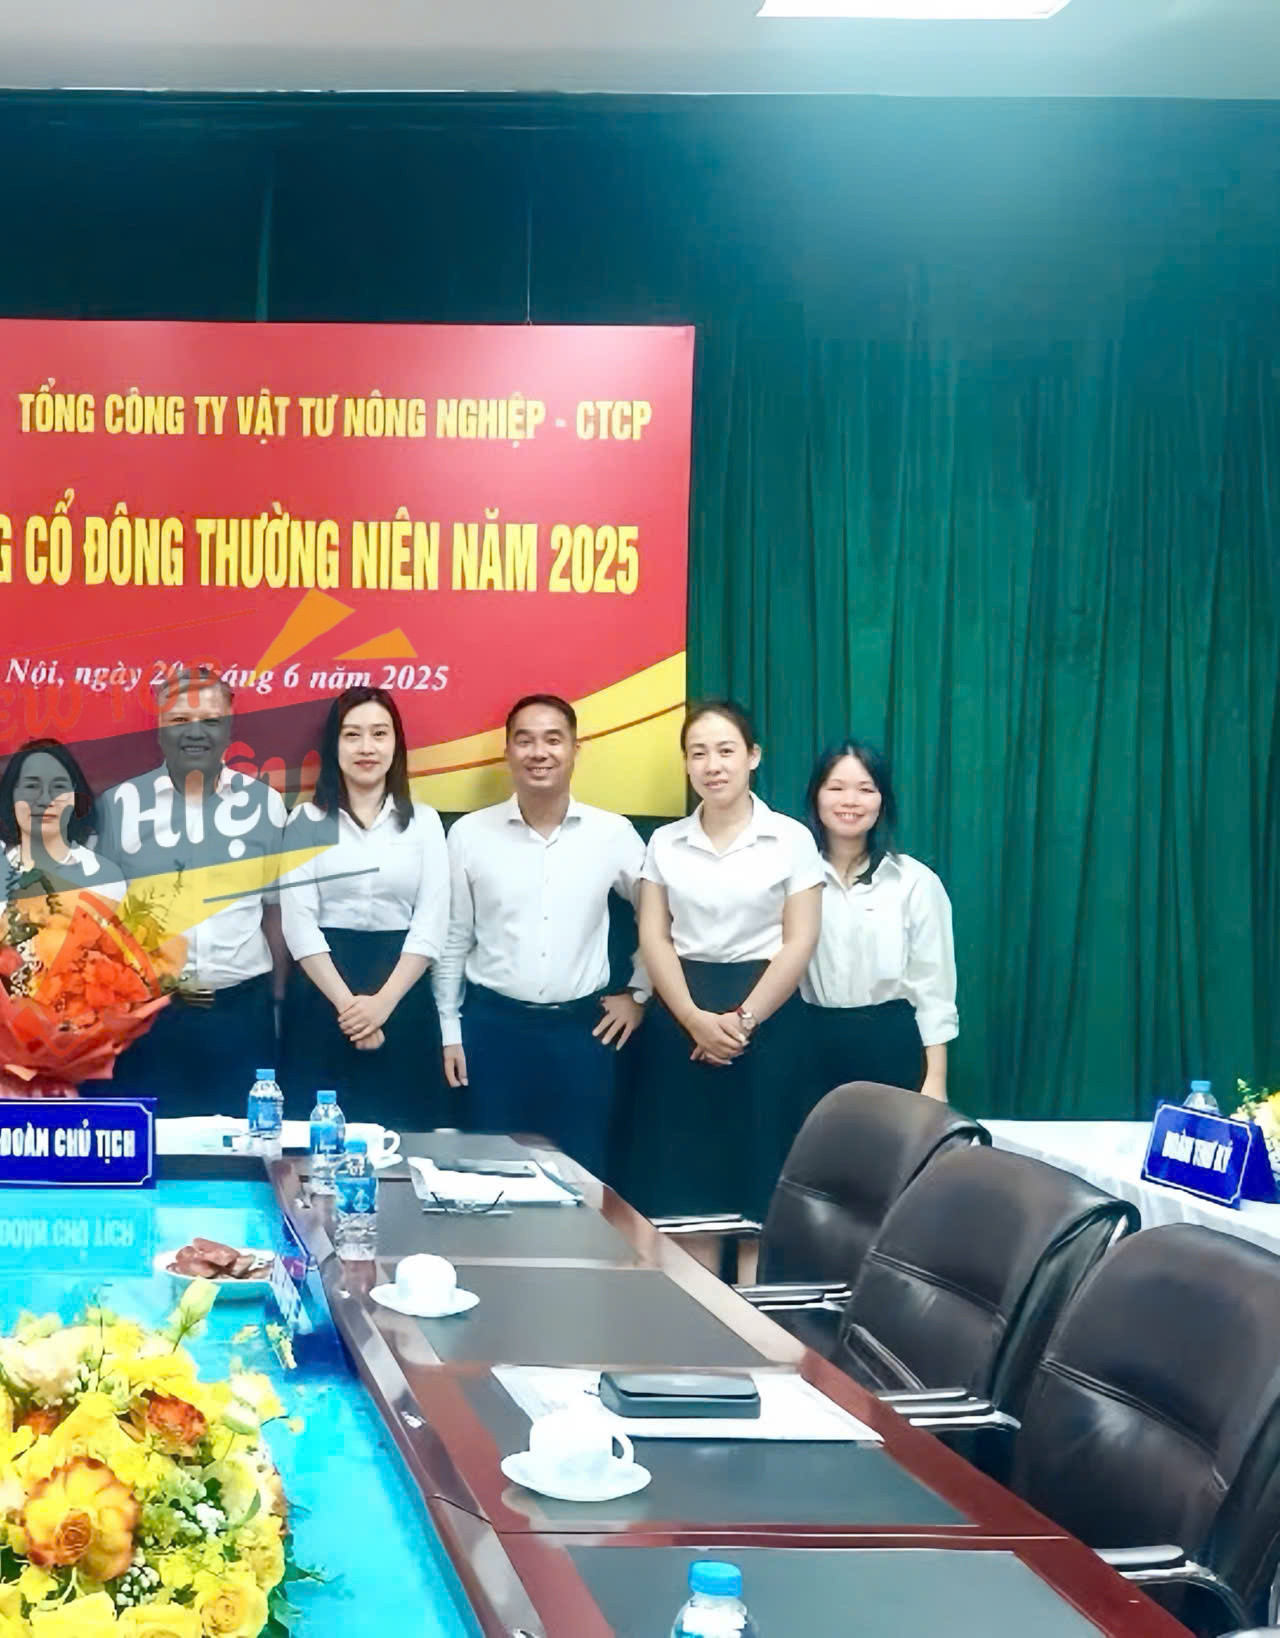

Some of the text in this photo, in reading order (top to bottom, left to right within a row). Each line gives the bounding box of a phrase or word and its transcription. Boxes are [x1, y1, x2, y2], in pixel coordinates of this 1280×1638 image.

[19, 377, 95, 433] TỔNG
[104, 386, 185, 435] CÔNG
[194, 395, 229, 435] TY
[237, 388, 291, 445] VẬT
[299, 393, 339, 438] TƯ
[344, 388, 427, 439] NÔNG
[434, 391, 547, 448] NGHIỆP
[576, 399, 656, 442] CTCP
[25, 487, 75, 586] CỔ
[83, 501, 184, 586] ĐÔNG
[195, 502, 340, 590] THƯỜNG
[352, 506, 441, 591] NIÊN
[452, 507, 538, 593] NĂM
[549, 522, 639, 595] 2025
[6, 658, 64, 690] Nội,
[75, 661, 142, 692] ngày
[283, 663, 300, 688] 6
[309, 666, 371, 690] năm
[379, 665, 449, 691] 2025
[0, 1118, 136, 1164] ĐOÀN CHỦ TỊCH
